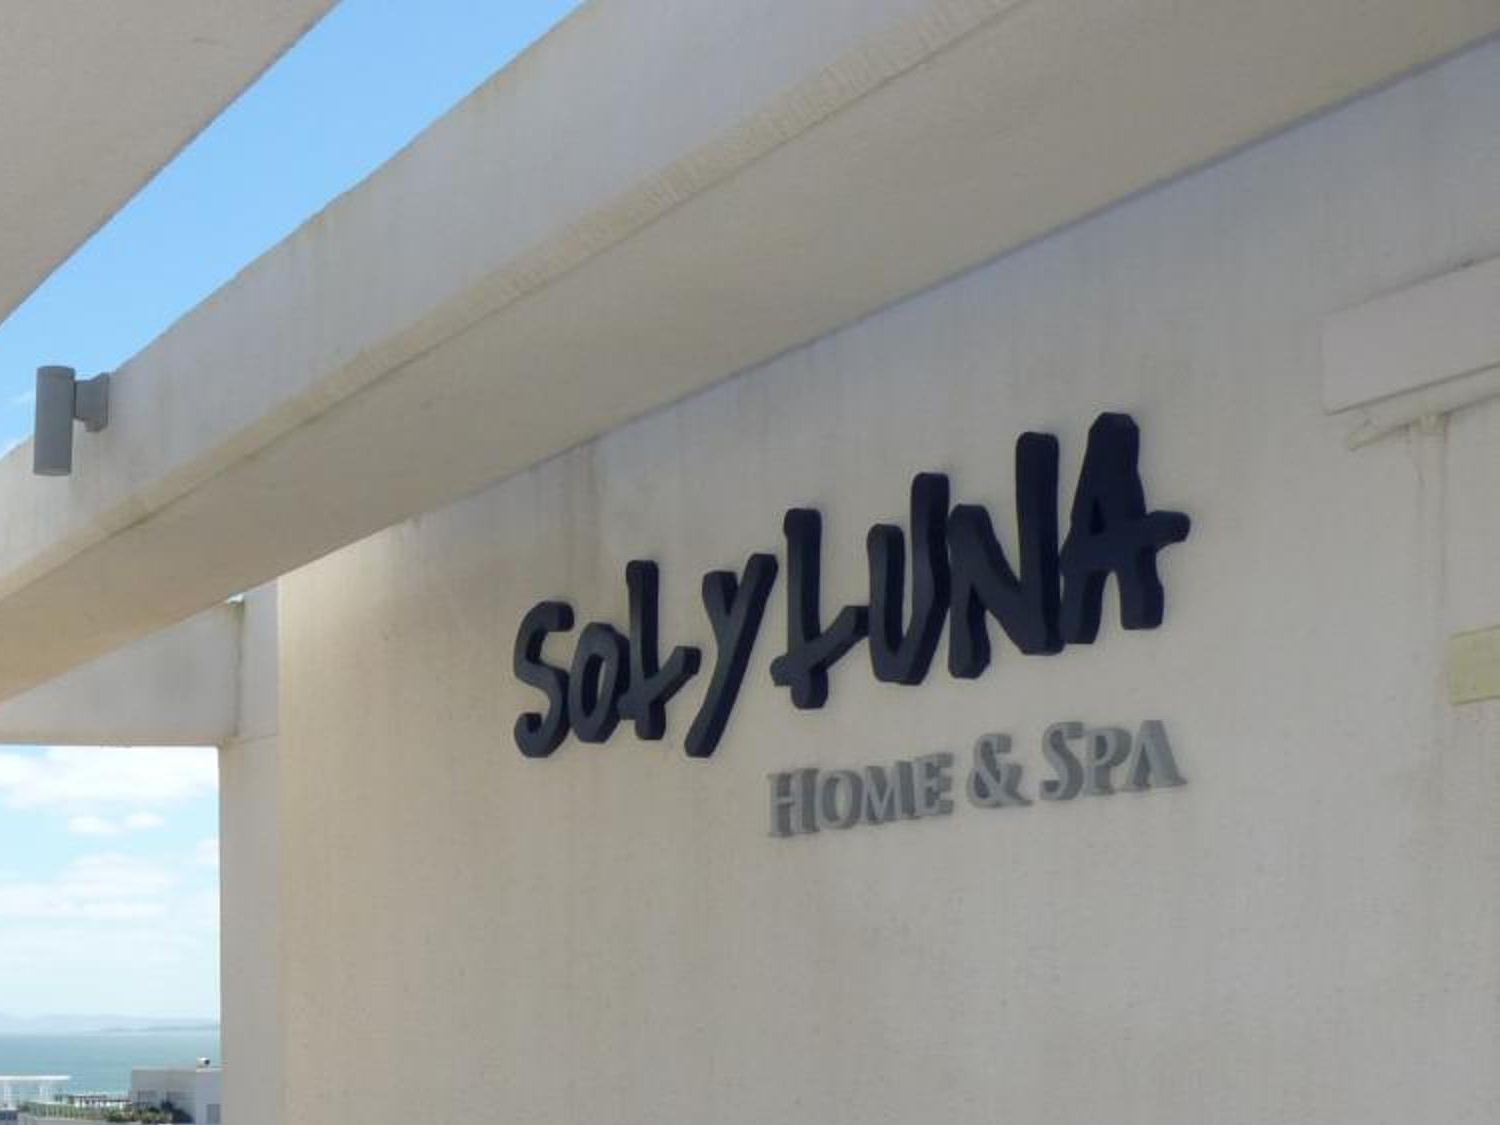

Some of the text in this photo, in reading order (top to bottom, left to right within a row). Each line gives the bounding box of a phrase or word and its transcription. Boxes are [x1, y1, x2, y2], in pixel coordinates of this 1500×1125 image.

[767, 720, 1187, 838] HOME & SPA
